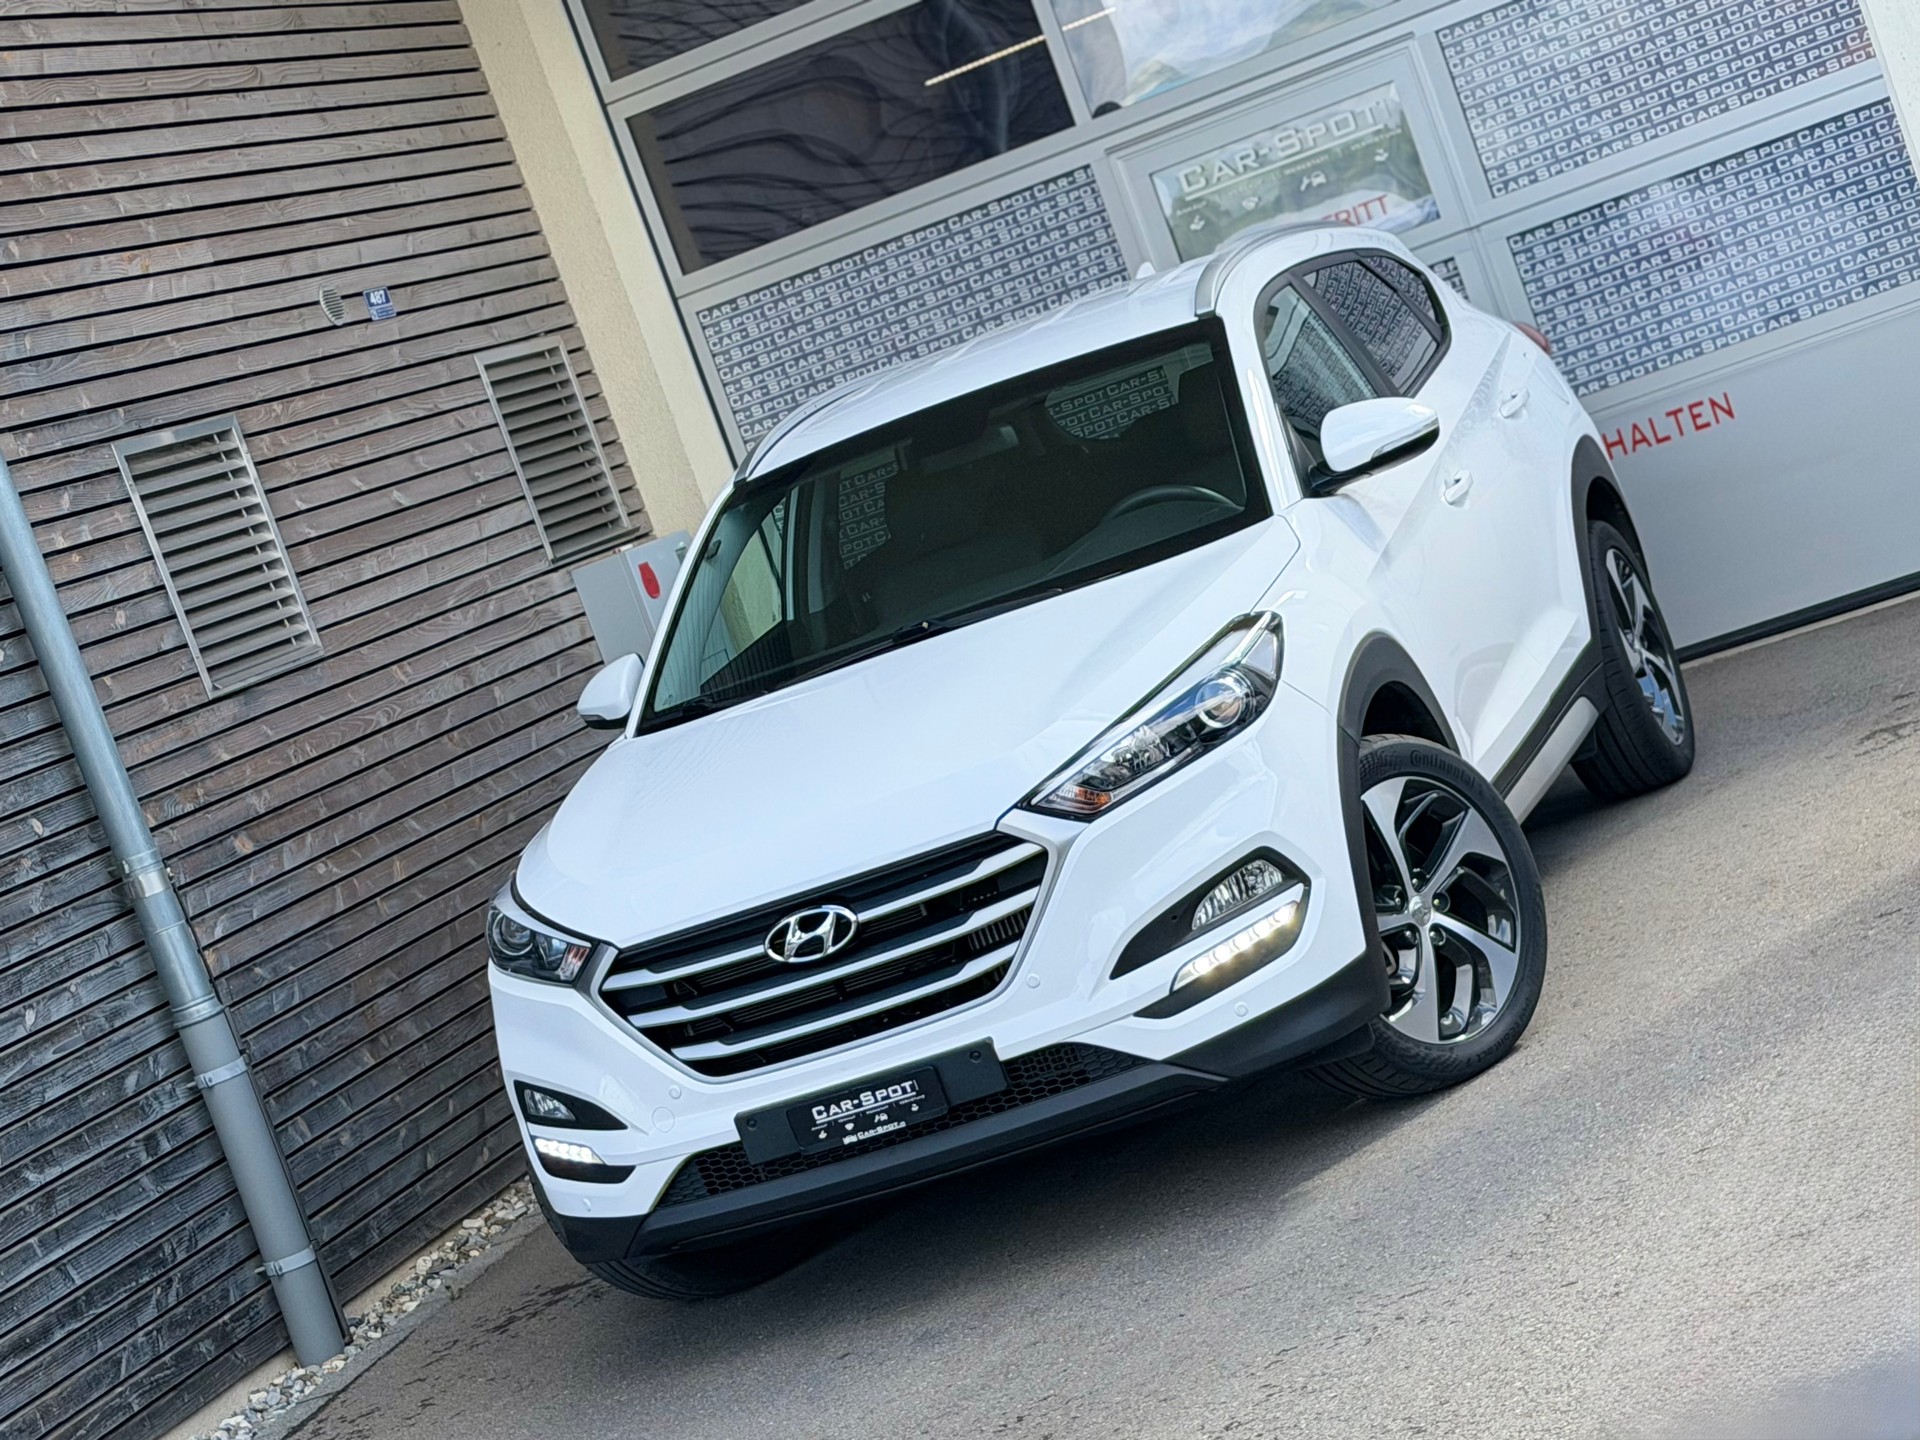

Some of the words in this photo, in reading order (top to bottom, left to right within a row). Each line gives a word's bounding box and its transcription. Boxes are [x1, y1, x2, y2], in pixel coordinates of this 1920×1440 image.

[1443, 25, 1512, 59] R-SPOT
[1448, 29, 1542, 72] CAR-SPOT
[1454, 54, 1522, 88] R-SPOT
[1521, 18, 1617, 62] CAR-SPOT
[1459, 61, 1553, 104] CAR-SPOT
[1552, 24, 1649, 69] CAR-SPOT
[1465, 86, 1533, 120] R-SPOT
[1532, 50, 1628, 94] CAR-SPOT
[1627, 13, 1725, 58] CAR-SPOT
[1469, 91, 1564, 134] CAR-SPOT
[1563, 54, 1659, 98] CAR-SPOT
[1659, 18, 1756, 62] CAR-SPOT
[1475, 116, 1544, 150] R-SPOT
[1542, 80, 1639, 124] CAR-SPOT
[1638, 43, 1736, 88] CAR-SPOT
[1735, 6, 1834, 51] CAR-SPOT
[1178, 101, 1381, 193] CAR-SPOT
[1480, 123, 1575, 165] CAR-SPOT
[1574, 87, 1670, 130] CAR-SPOT
[1670, 50, 1767, 94] CAR-SPOT
[1486, 148, 1555, 181] R-SPOT
[1554, 112, 1650, 156] CAR-SPOT
[1649, 76, 1746, 120] CAR-SPOT
[1746, 39, 1845, 84] CAR-SPOT
[1491, 154, 1586, 197] CAR-SPOT
[1585, 118, 1681, 162] CAR-SPOT
[1680, 82, 1778, 126] CAR-SPOT
[1509, 207, 1603, 249] CAR-SPOT
[1602, 172, 1698, 214] CAR-SPOT
[1698, 136, 1796, 179] CAR-SPOT
[1514, 232, 1582, 265] R-SPOT
[1582, 197, 1678, 240] CAR-SPOT
[1677, 162, 1775, 205] CAR-SPOT
[1776, 125, 1875, 170] CAR-SPOT
[1518, 236, 1612, 278] CAR-SPOT
[1612, 202, 1708, 244] CAR-SPOT
[1708, 166, 1806, 210] CAR-SPOT
[1524, 262, 1592, 294] R-SPOT
[1592, 227, 1688, 269] CAR-SPOT
[1688, 192, 1785, 235] CAR-SPOT
[1786, 156, 1885, 200] CAR-SPOT
[370, 290, 386, 305] 487
[696, 285, 781, 323] CAR-SPOT
[779, 254, 863, 292] CAR-SPOT
[862, 222, 948, 261] CAR-SPOT
[946, 190, 1033, 229] CAR-SPOT
[703, 308, 764, 338] R-SPOT
[762, 277, 846, 316] CAR-SPOT
[845, 246, 930, 285] CAR-SPOT
[929, 214, 1015, 253] CAR-SPOT
[707, 314, 791, 351] CAR-SPOT
[789, 282, 874, 320] CAR-SPOT
[872, 251, 958, 289] CAR-SPOT
[957, 219, 1044, 258] CAR-SPOT
[713, 337, 774, 366] R-SPOT
[772, 306, 857, 344] CAR-SPOT
[855, 274, 941, 313] CAR-SPOT
[940, 242, 1026, 282] CAR-SPOT
[1529, 268, 1624, 309] CAR-SPOT
[1624, 234, 1719, 275] CAR-SPOT
[1719, 198, 1817, 241] CAR-SPOT
[1535, 293, 1604, 325] R-SPOT
[1603, 259, 1699, 300] CAR-SPOT
[1699, 224, 1796, 267] CAR-SPOT
[1797, 189, 1895, 232] CAR-SPOT
[1550, 322, 1614, 353] R-SPOT
[1613, 289, 1709, 330] CAR-SPOT
[1709, 254, 1806, 297] CAR-SPOT
[1807, 219, 1906, 262] CAR-SPOT
[1624, 321, 1720, 362] CAR-SPOT
[1720, 287, 1817, 328] CAR-SPOT
[1818, 252, 1917, 294] CAR-SPOT
[1634, 264, 1730, 305] CAR-SPOT
[1730, 229, 1828, 271] CAR-SPOT
[1645, 295, 1740, 337] CAR-SPOT
[1741, 261, 1839, 303] CAR-SPOT
[718, 343, 801, 380] CAR-SPOT
[800, 312, 885, 350] CAR-SPOT
[883, 281, 969, 319] CAR-SPOT
[968, 249, 1055, 288] CAR-SPOT
[724, 366, 785, 395] R-SPOT
[783, 335, 868, 373] CAR-SPOT
[866, 304, 951, 343] CAR-SPOT
[951, 273, 1037, 311] CAR-SPOT
[728, 371, 812, 408] CAR-SPOT
[810, 340, 895, 378] CAR-SPOT
[893, 309, 979, 347] CAR-SPOT
[978, 278, 1065, 316] CAR-SPOT
[1656, 327, 1751, 369] CAR-SPOT
[1752, 293, 1849, 335] CAR-SPOT
[735, 394, 795, 422] R-SPOT
[1601, 392, 1736, 461] HALTEN
[811, 1080, 913, 1120] CAR-SPOT
